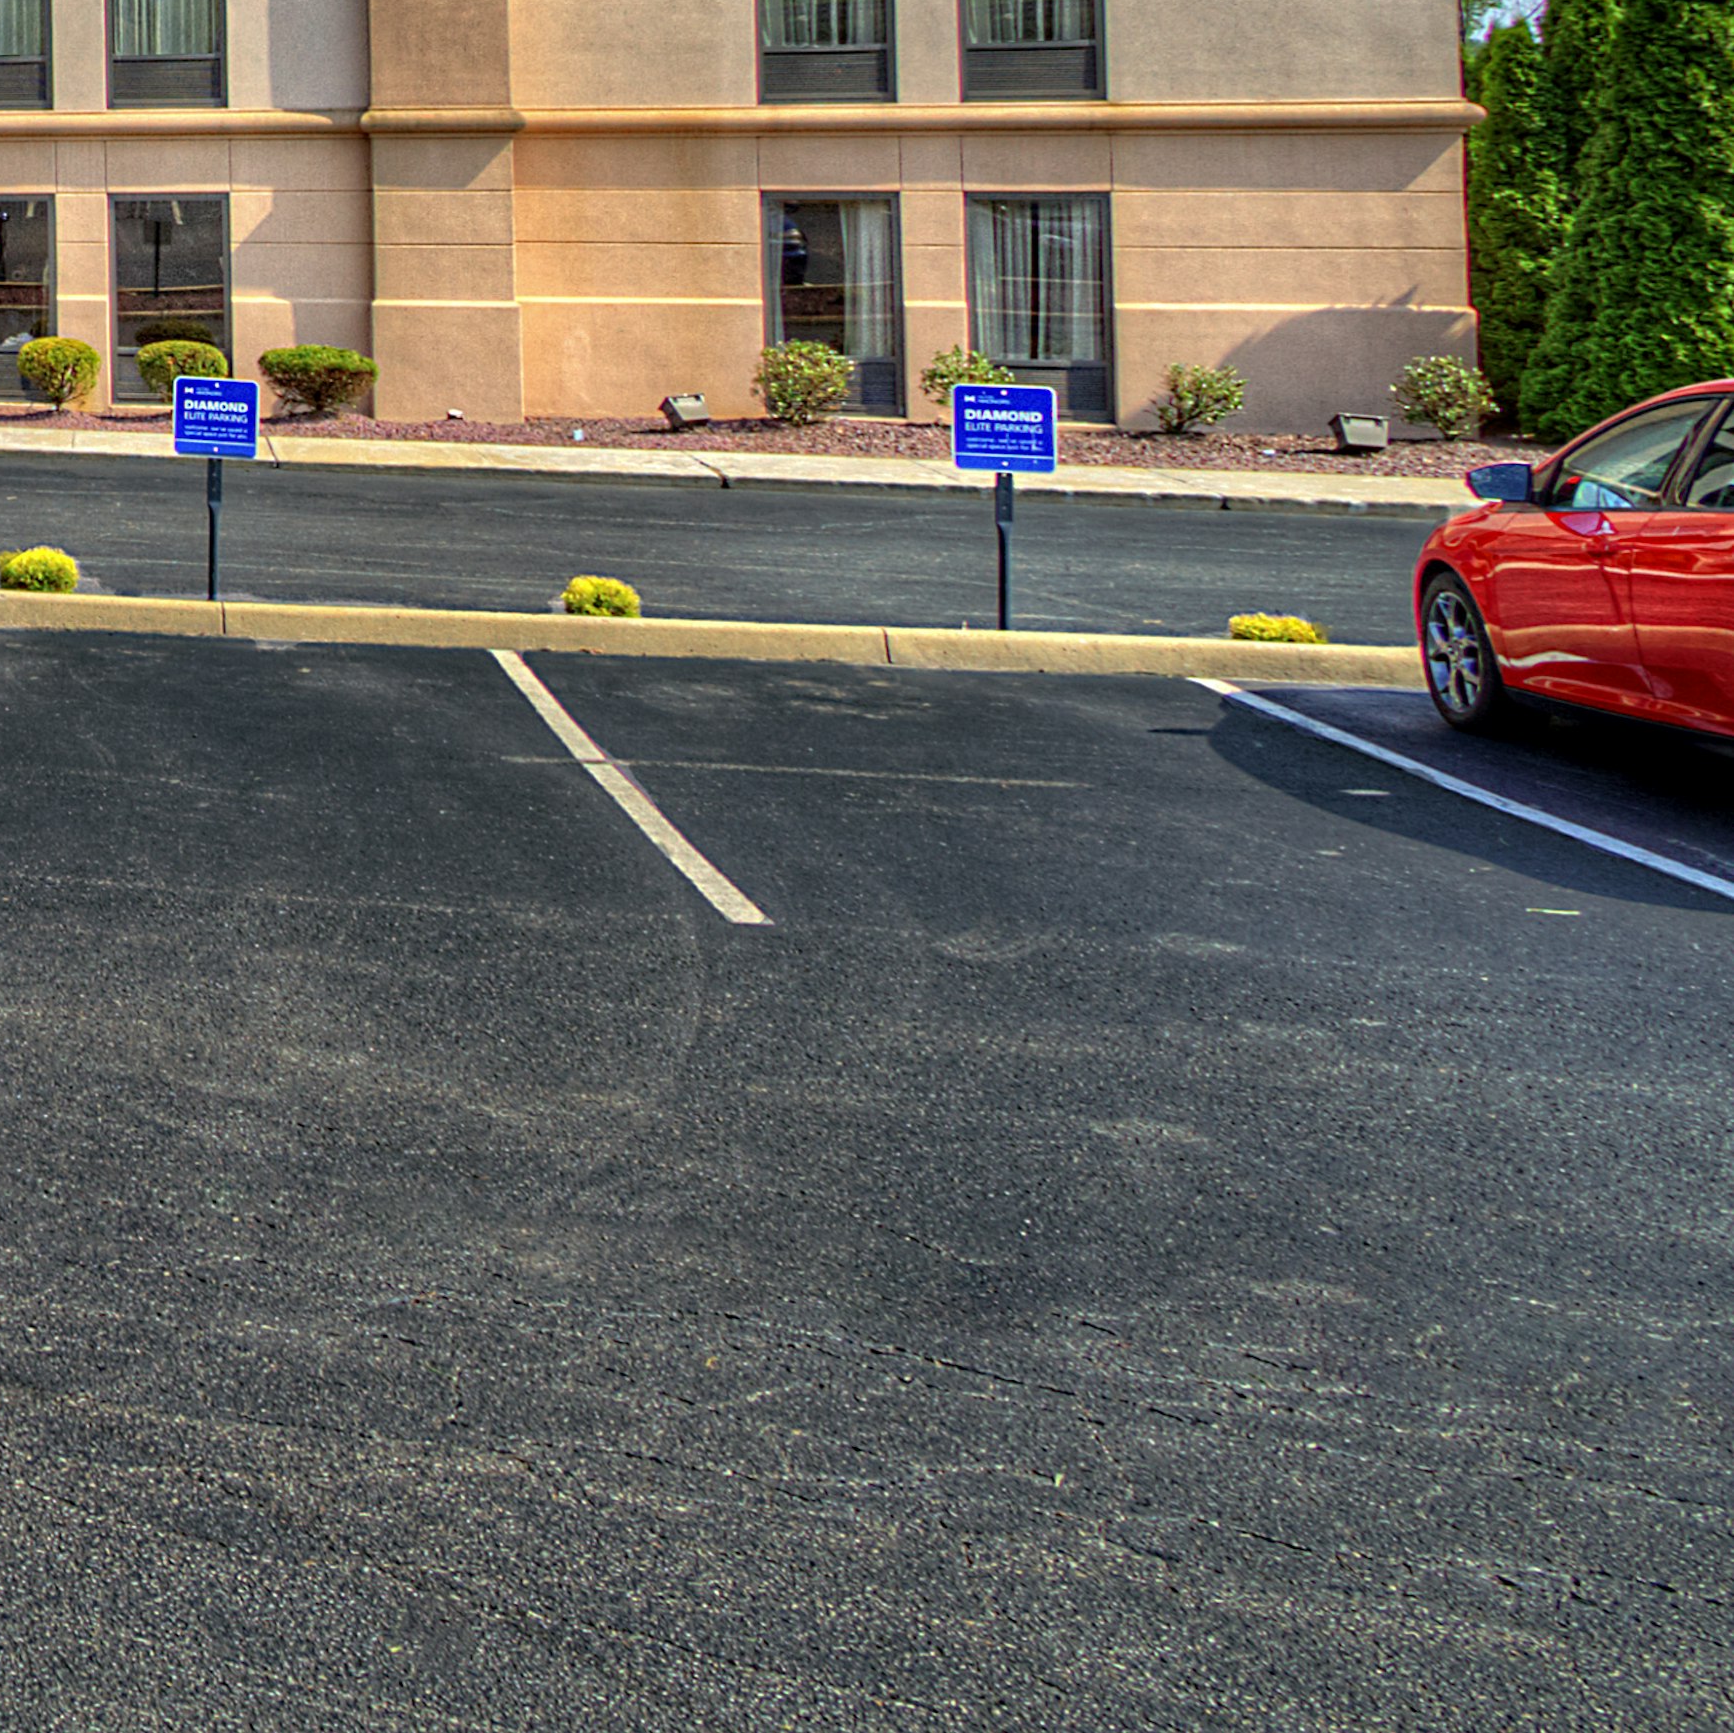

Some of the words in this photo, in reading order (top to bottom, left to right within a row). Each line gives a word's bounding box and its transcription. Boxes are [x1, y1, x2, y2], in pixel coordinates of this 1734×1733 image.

[184, 399, 248, 413] DIAMOND
[184, 411, 206, 421] ELITE
[208, 412, 248, 424] PARKING
[964, 409, 1043, 423] DIAMOND
[965, 422, 992, 432] ELITE
[994, 423, 1043, 434] PARKING
